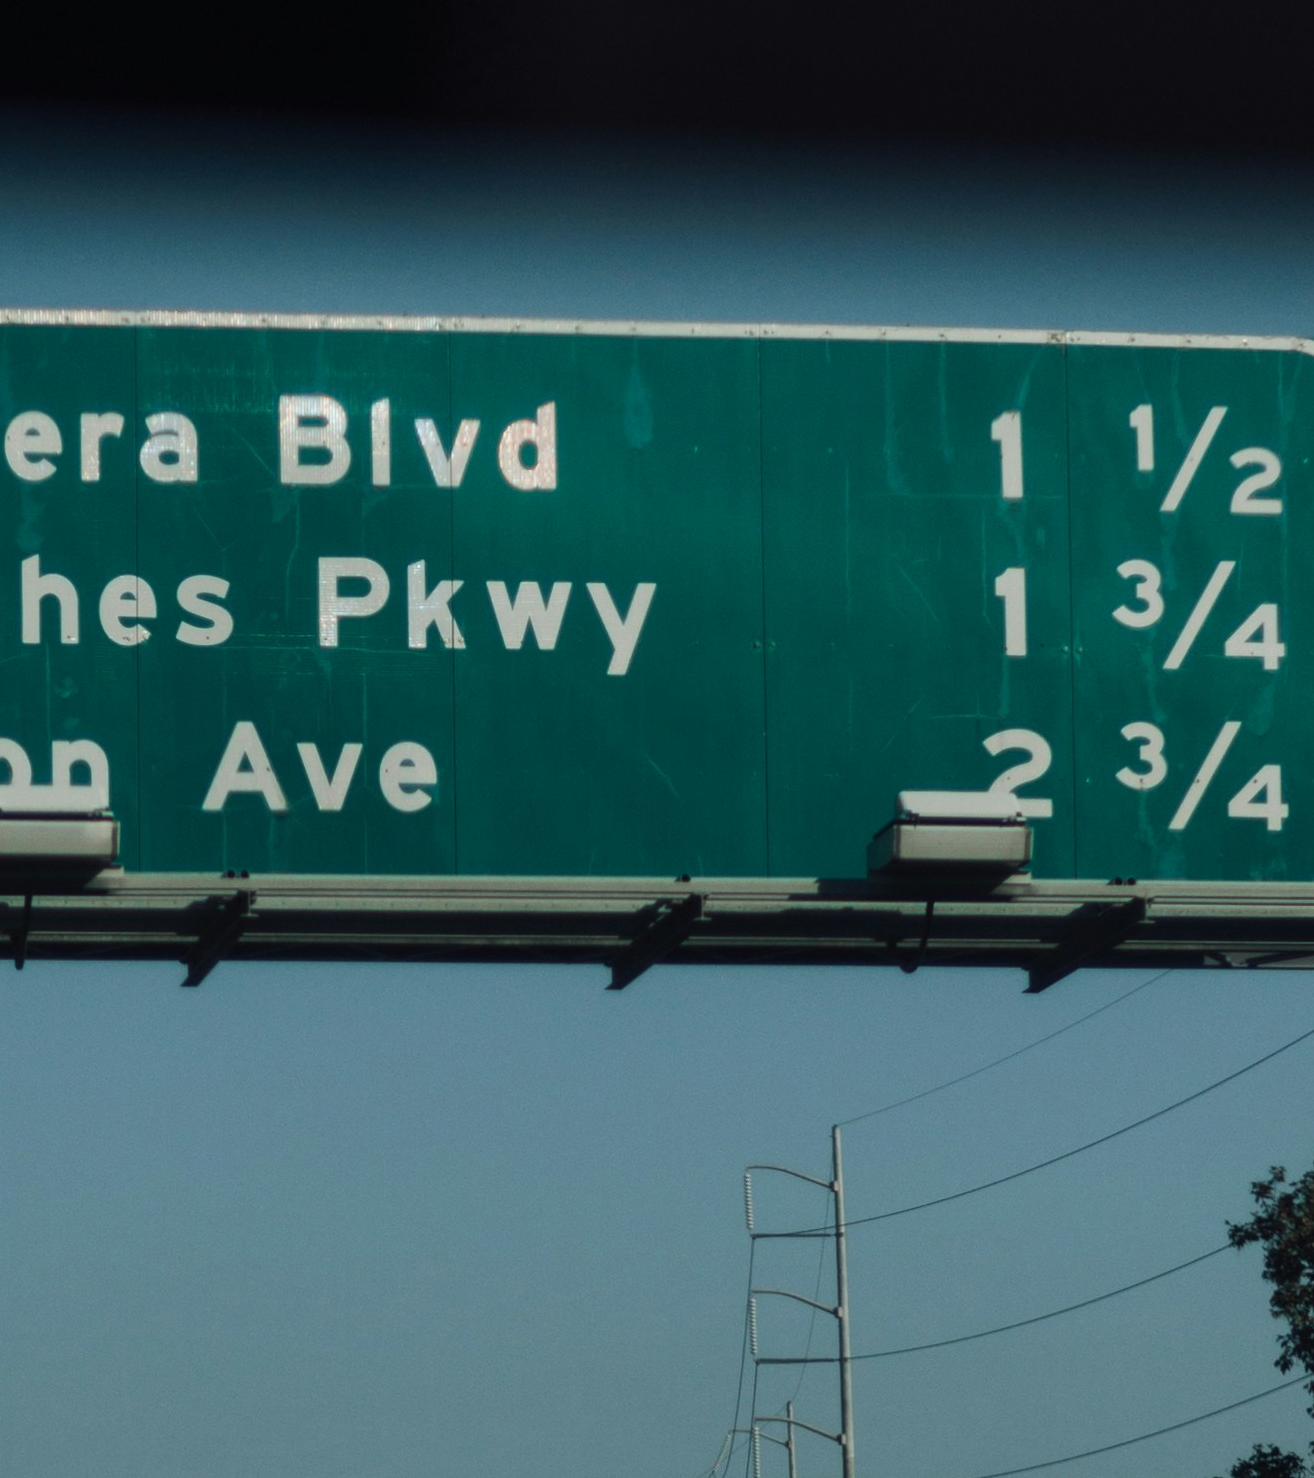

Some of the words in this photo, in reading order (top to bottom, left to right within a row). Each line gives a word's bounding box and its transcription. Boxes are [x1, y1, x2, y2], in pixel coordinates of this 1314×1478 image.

[278, 393, 557, 490] Blvd
[990, 411, 1024, 499] 1
[318, 556, 657, 676] Pkwy
[995, 567, 1027, 657] 1
[202, 720, 438, 813] Ave
[982, 729, 1053, 819] 2
